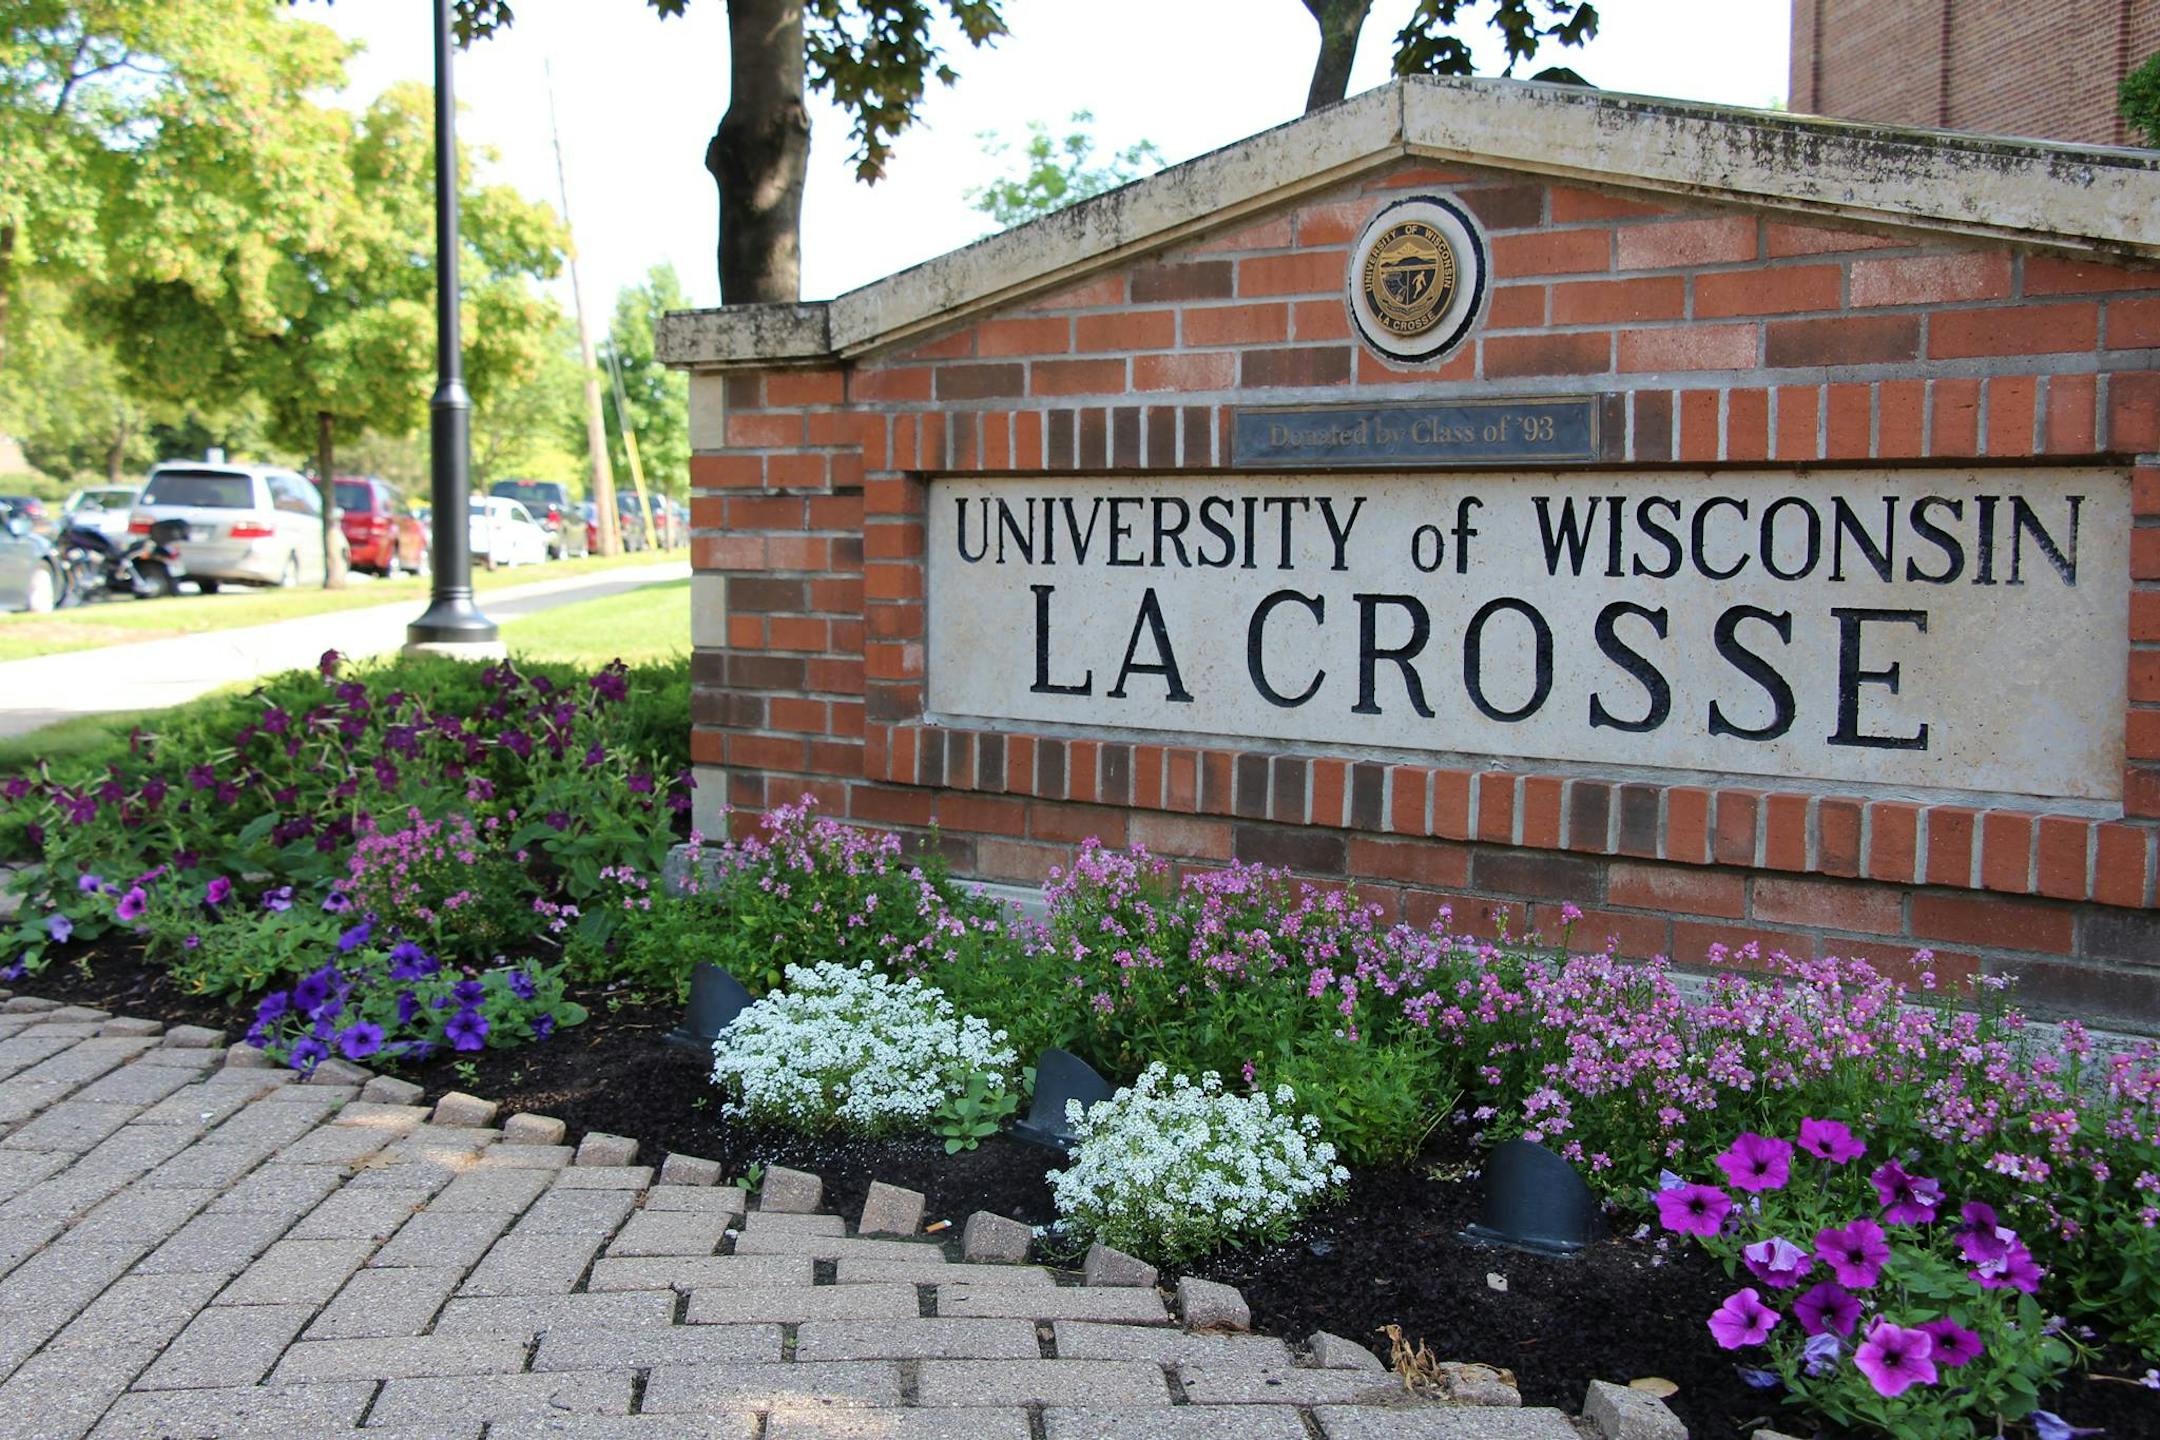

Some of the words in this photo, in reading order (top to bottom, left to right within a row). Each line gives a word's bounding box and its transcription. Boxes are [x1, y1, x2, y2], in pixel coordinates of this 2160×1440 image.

[1366, 231, 1397, 293] UNIVERSITY
[1405, 225, 1418, 235] OF
[1424, 228, 1452, 289] WISCONSIN
[1377, 311, 1390, 328] LA
[1392, 311, 1436, 331] CROSSE
[1270, 417, 1368, 447] Donated
[1374, 416, 1404, 452] by
[1411, 416, 1474, 443] Class
[1483, 415, 1510, 442] of
[955, 495, 1367, 572] UNIVERSITY
[1411, 495, 1484, 574] of
[1531, 494, 2085, 588] WISCONSIN
[1030, 584, 1195, 703] LA
[1246, 588, 1929, 751] CROSSE
